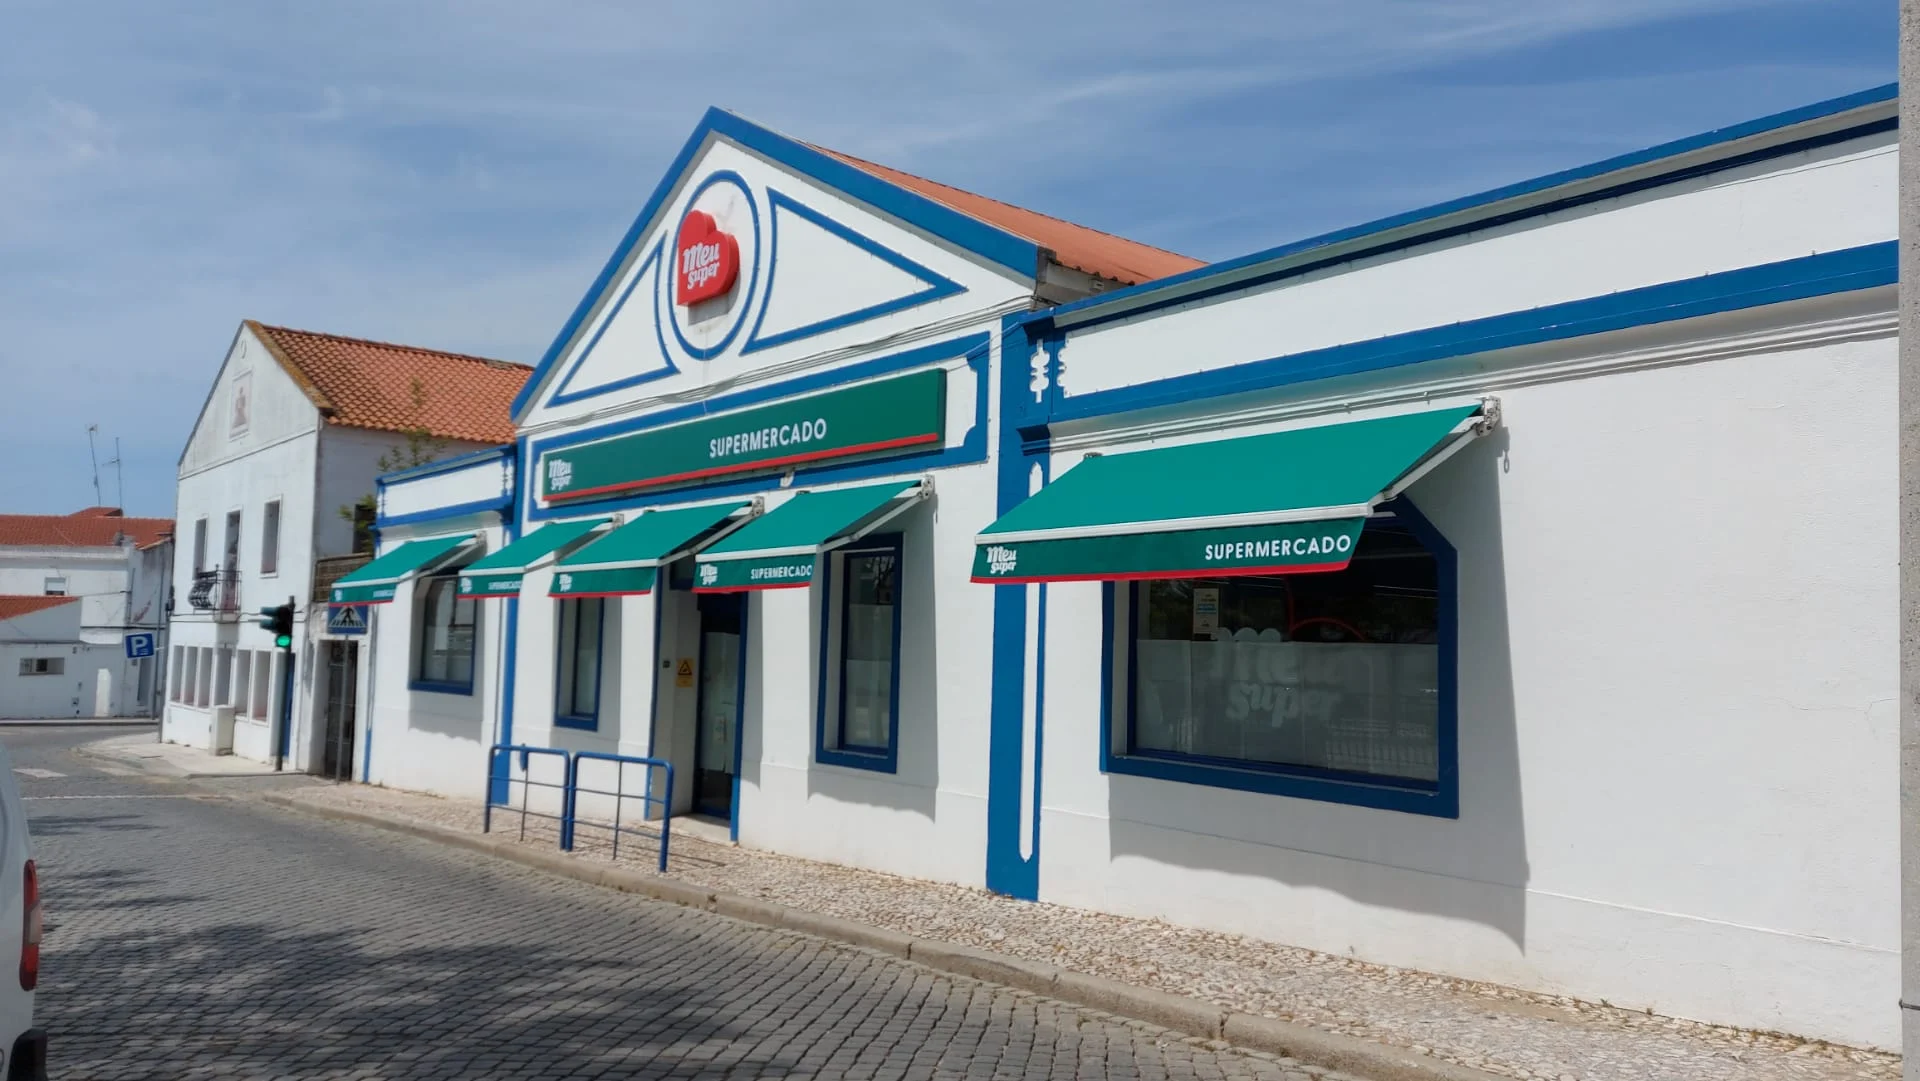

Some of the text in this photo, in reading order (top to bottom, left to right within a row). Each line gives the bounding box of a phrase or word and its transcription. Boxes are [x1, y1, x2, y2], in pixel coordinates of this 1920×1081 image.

[687, 262, 720, 289] super
[709, 418, 827, 458] SUPERMERCADO
[1205, 535, 1351, 561] SUPERMERCADO
[131, 636, 148, 656] P
